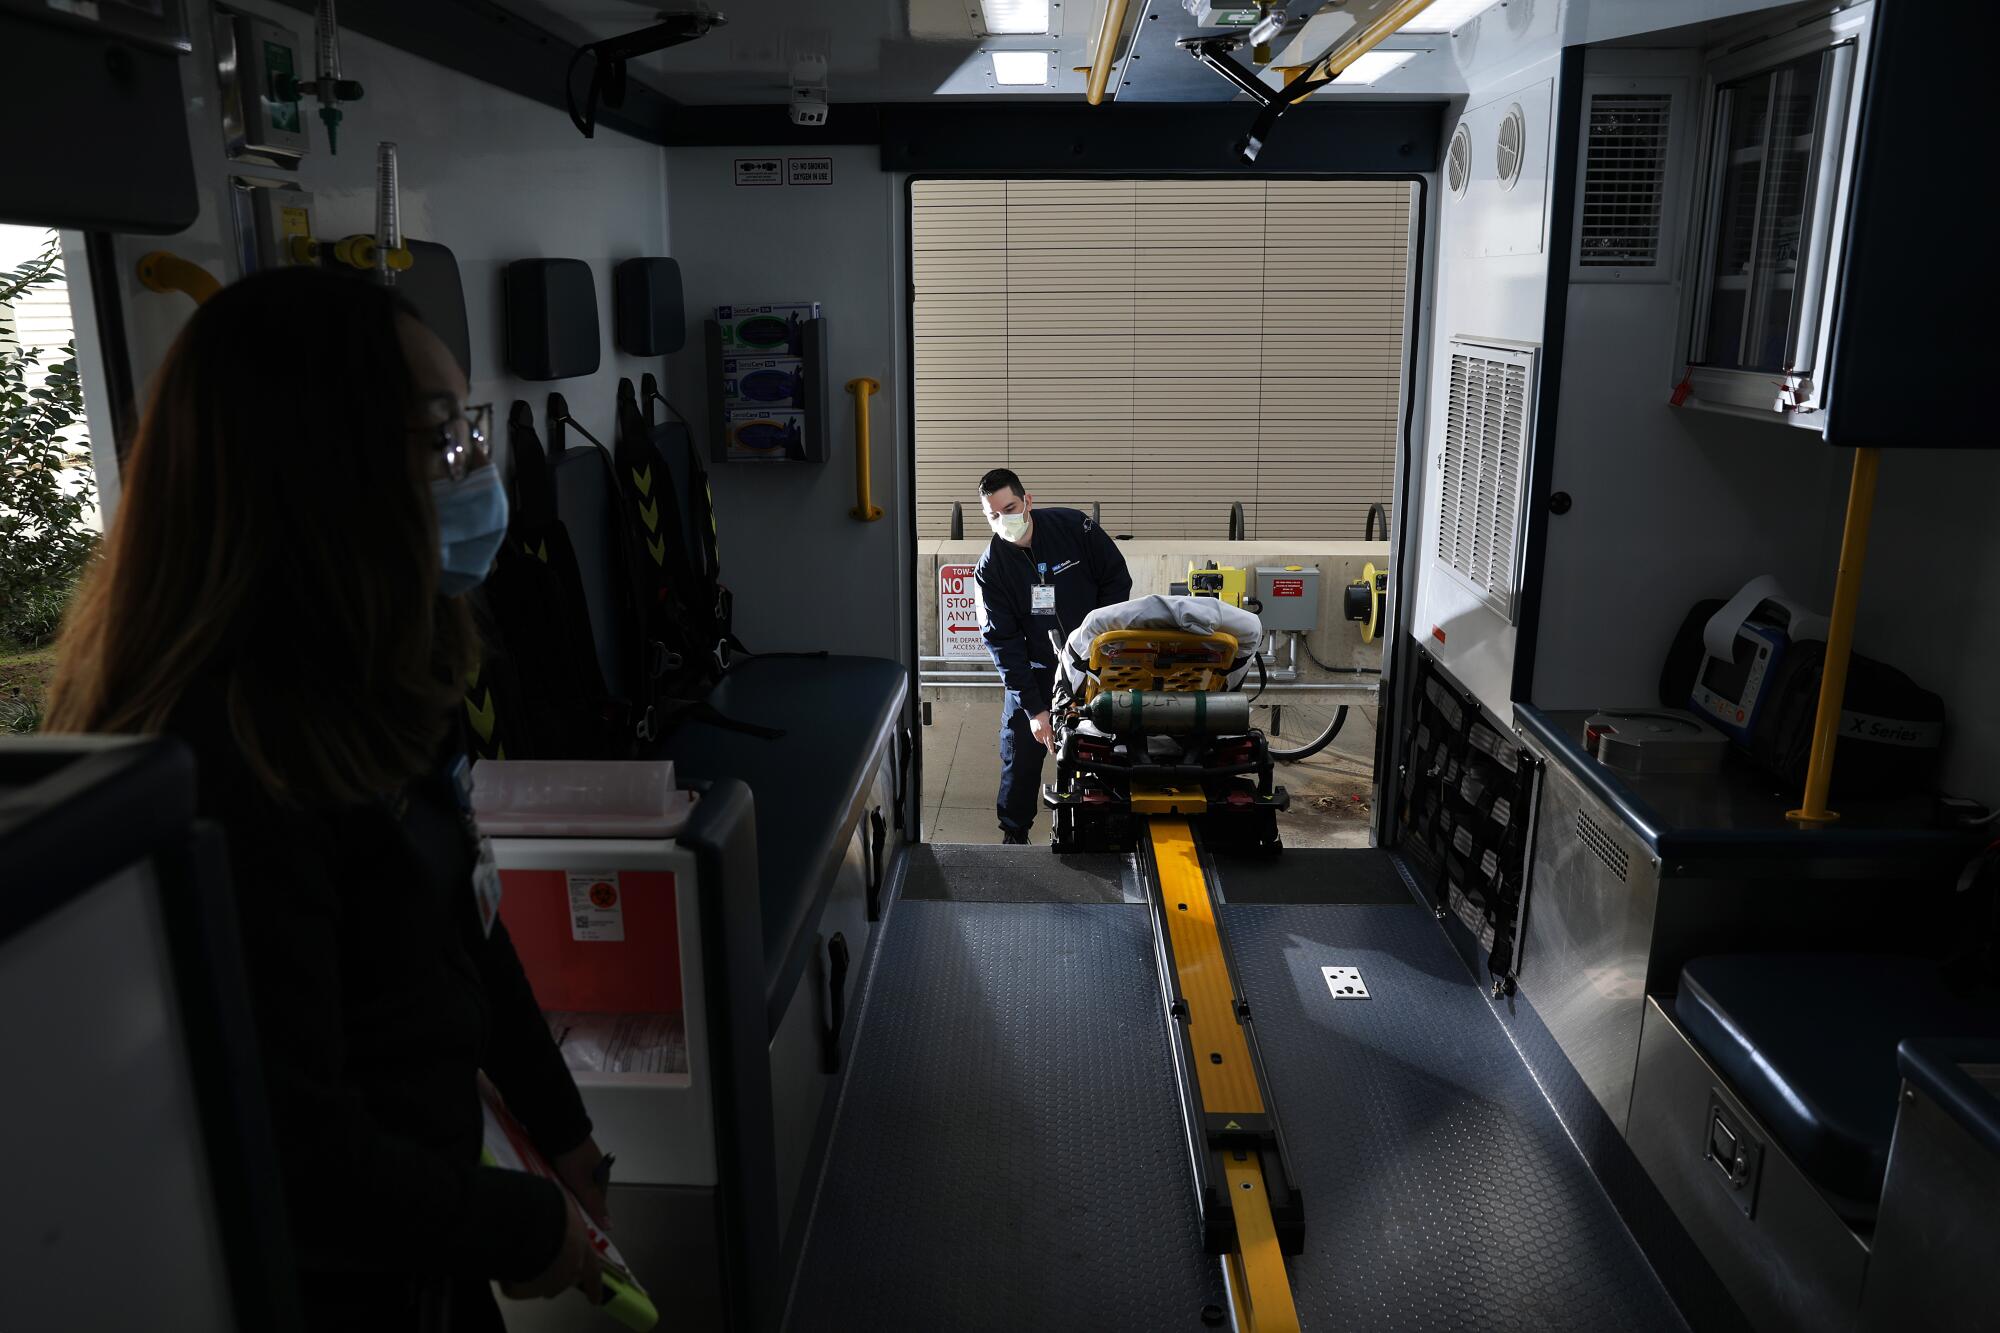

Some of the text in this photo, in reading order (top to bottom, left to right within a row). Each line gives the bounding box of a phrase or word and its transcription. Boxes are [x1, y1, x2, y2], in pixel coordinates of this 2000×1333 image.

[942, 578, 963, 593] NO
[947, 598, 975, 608] STOP
[947, 611, 977, 620] ANYT
[1850, 718, 1918, 741] X Series
